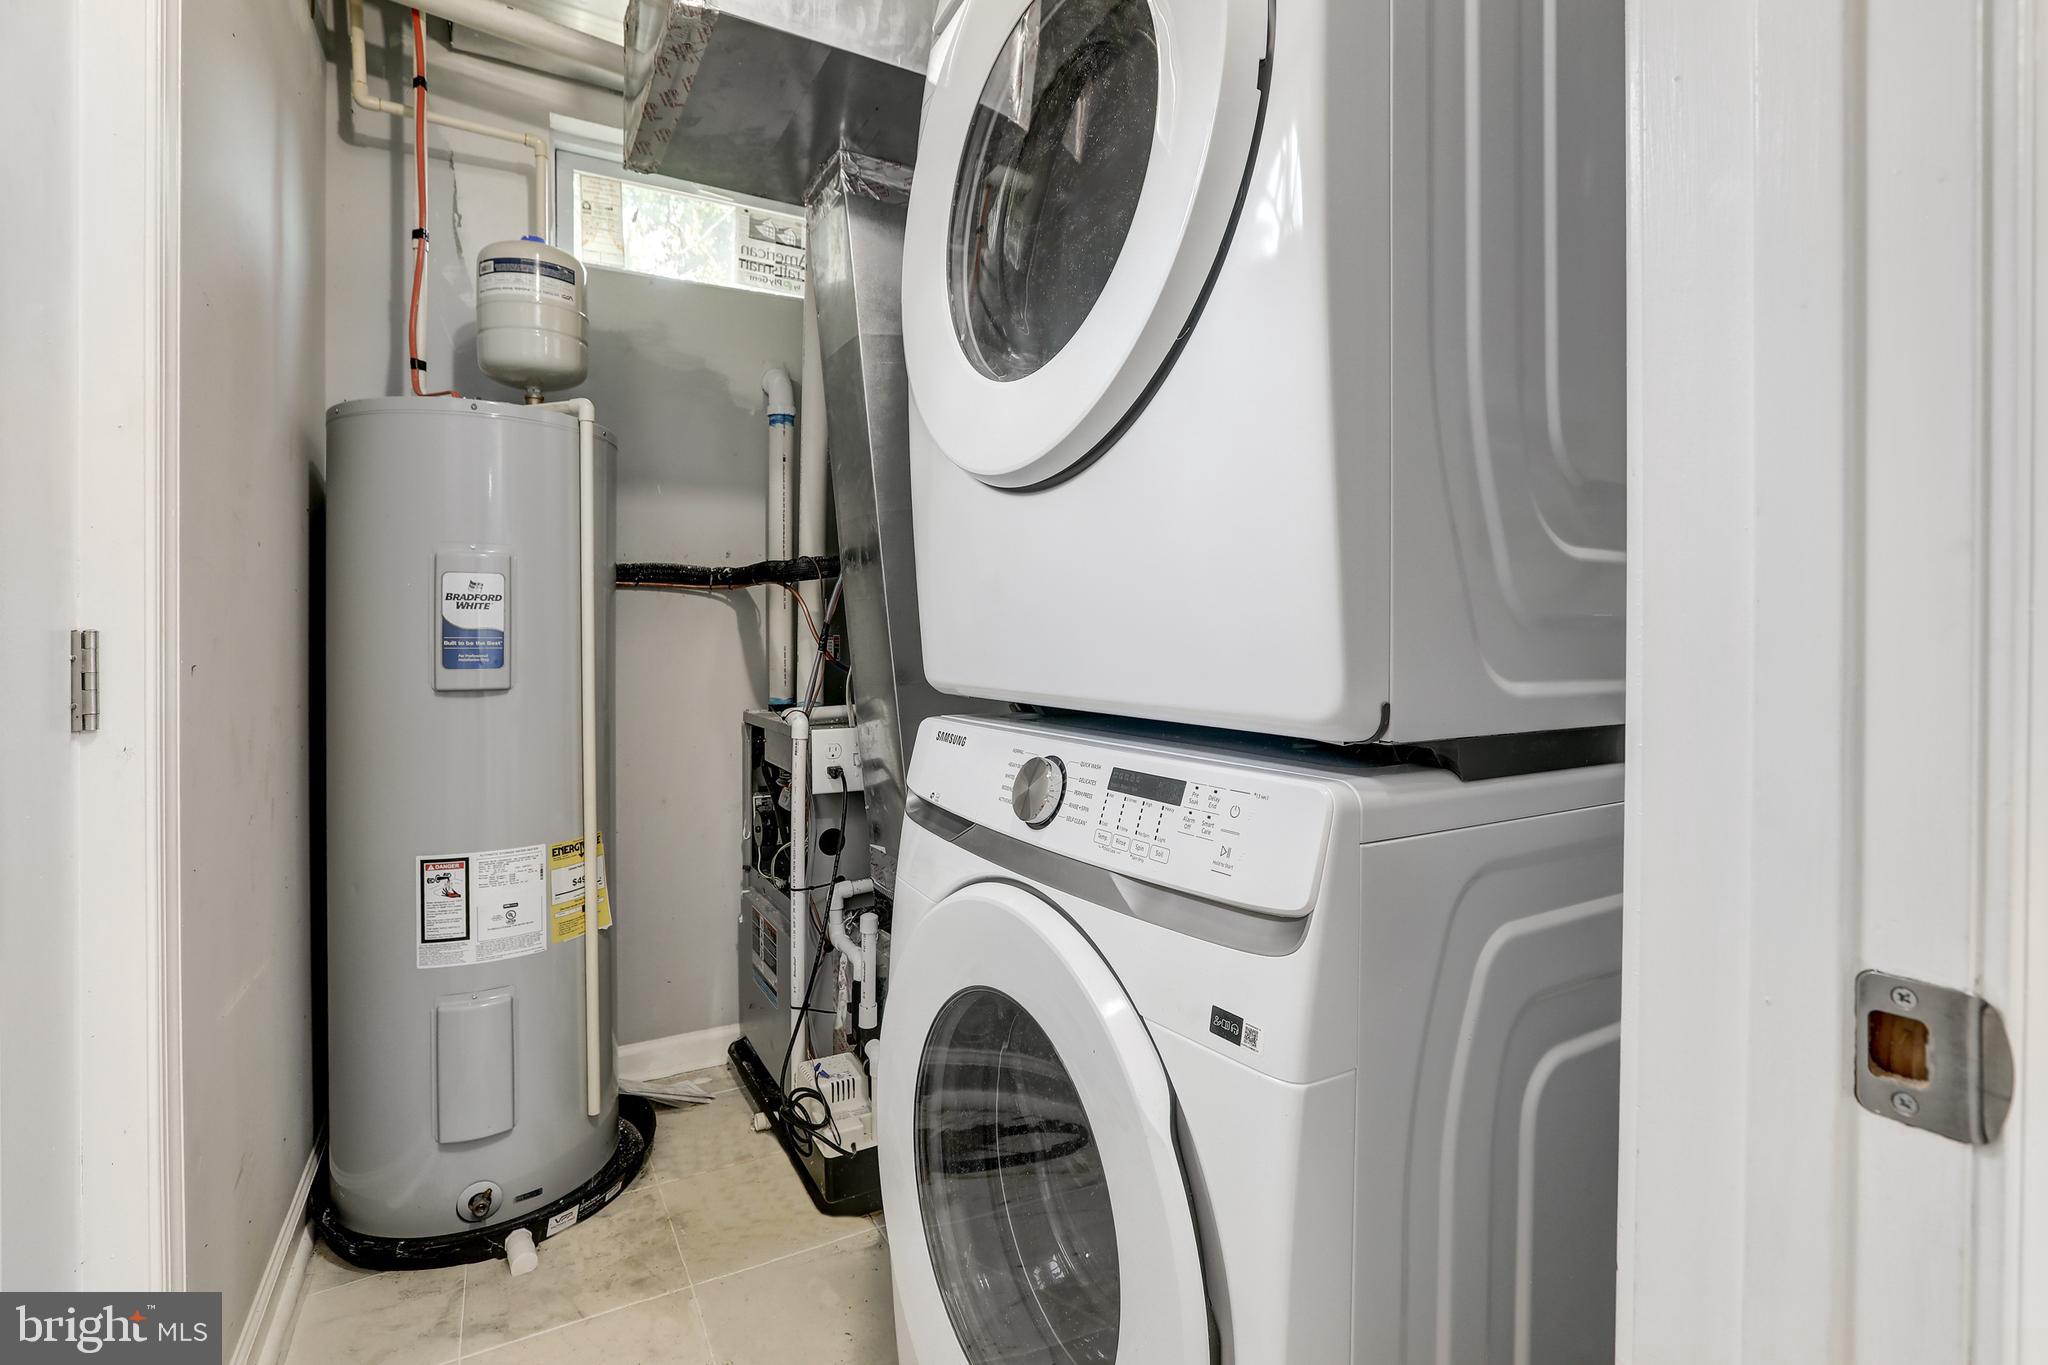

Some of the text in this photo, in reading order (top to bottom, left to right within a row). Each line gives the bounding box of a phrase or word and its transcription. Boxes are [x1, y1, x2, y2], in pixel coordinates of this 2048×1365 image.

[445, 593, 502, 602] BRADFORD
[456, 602, 490, 610] WHITE
[936, 730, 967, 747] SAMSUNG
[1208, 795, 1221, 803] Delay
[1202, 820, 1214, 828] Smart
[1116, 838, 1126, 846] Rinse
[1135, 843, 1144, 852] Spin
